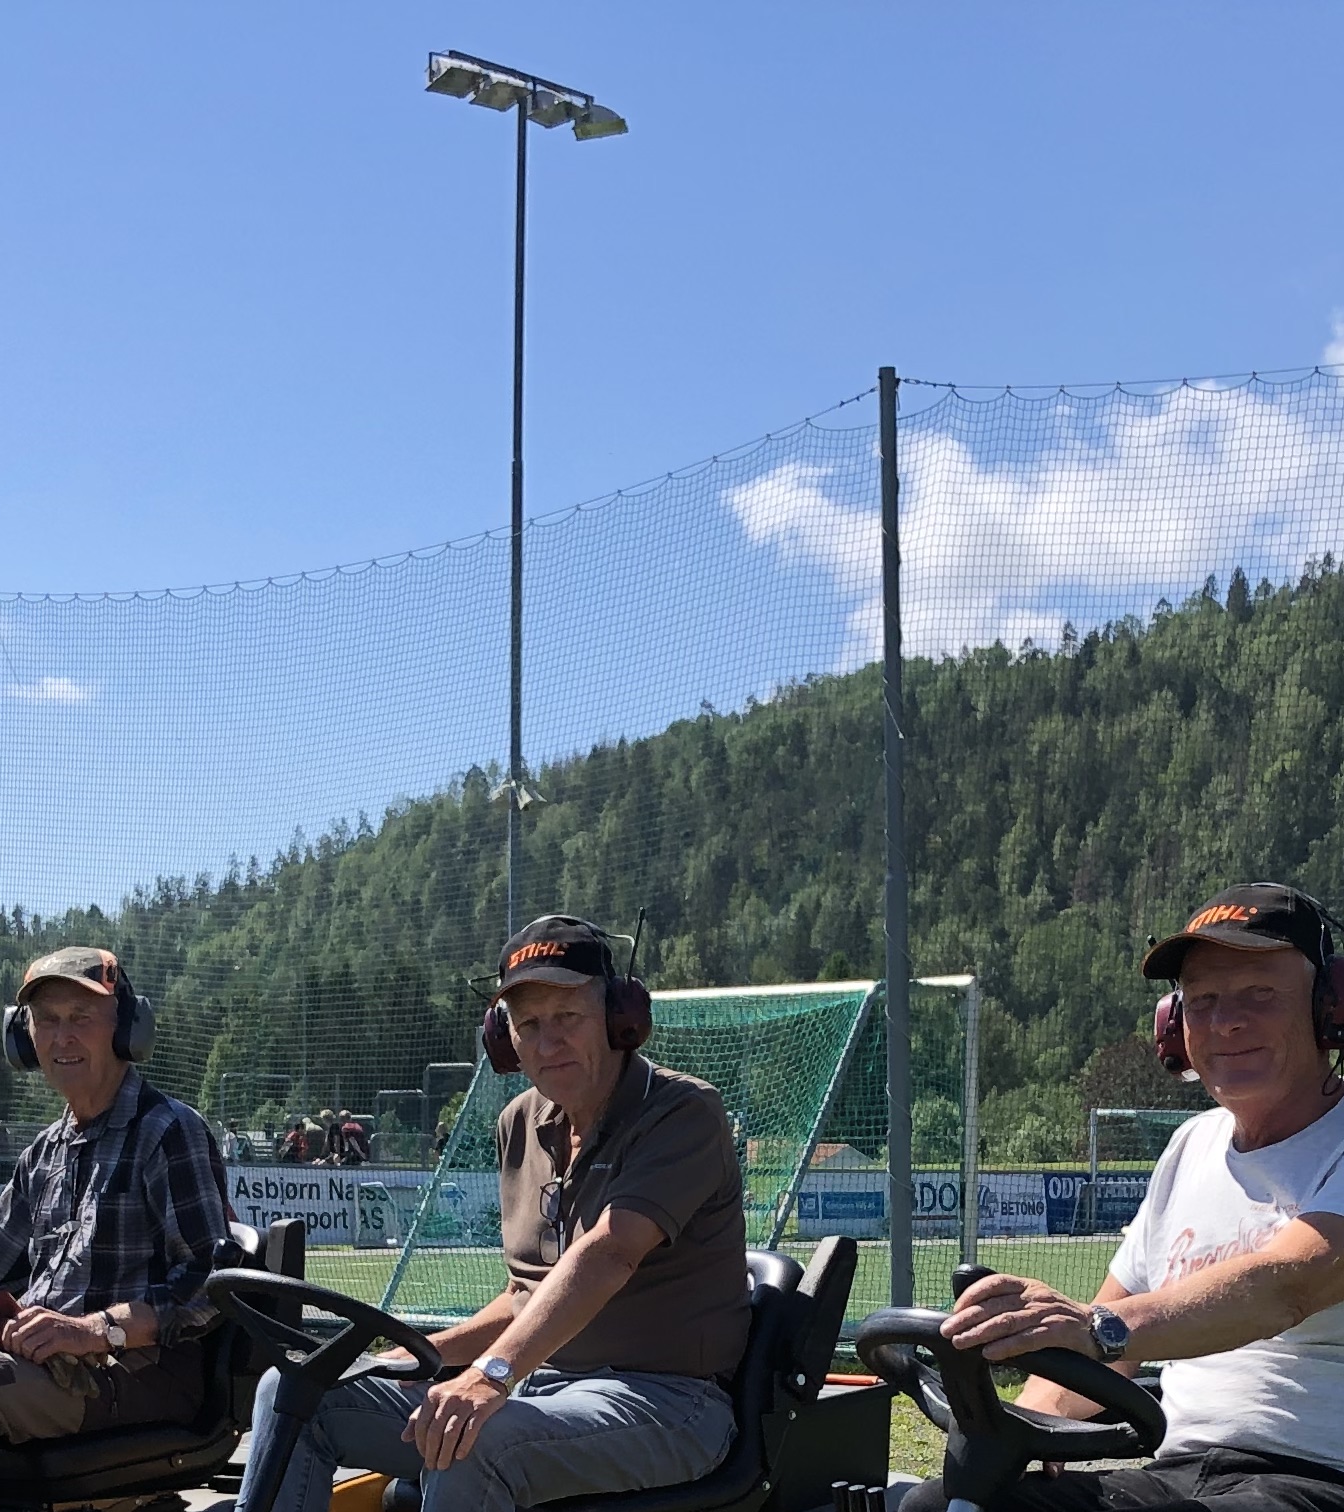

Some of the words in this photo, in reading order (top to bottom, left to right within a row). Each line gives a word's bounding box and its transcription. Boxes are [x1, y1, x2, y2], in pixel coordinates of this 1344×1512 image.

[509, 942, 566, 969] STIHL
[235, 1175, 321, 1205] Asbjørn
[359, 1206, 384, 1230] AS
[1000, 1200, 1045, 1216] BETONG
